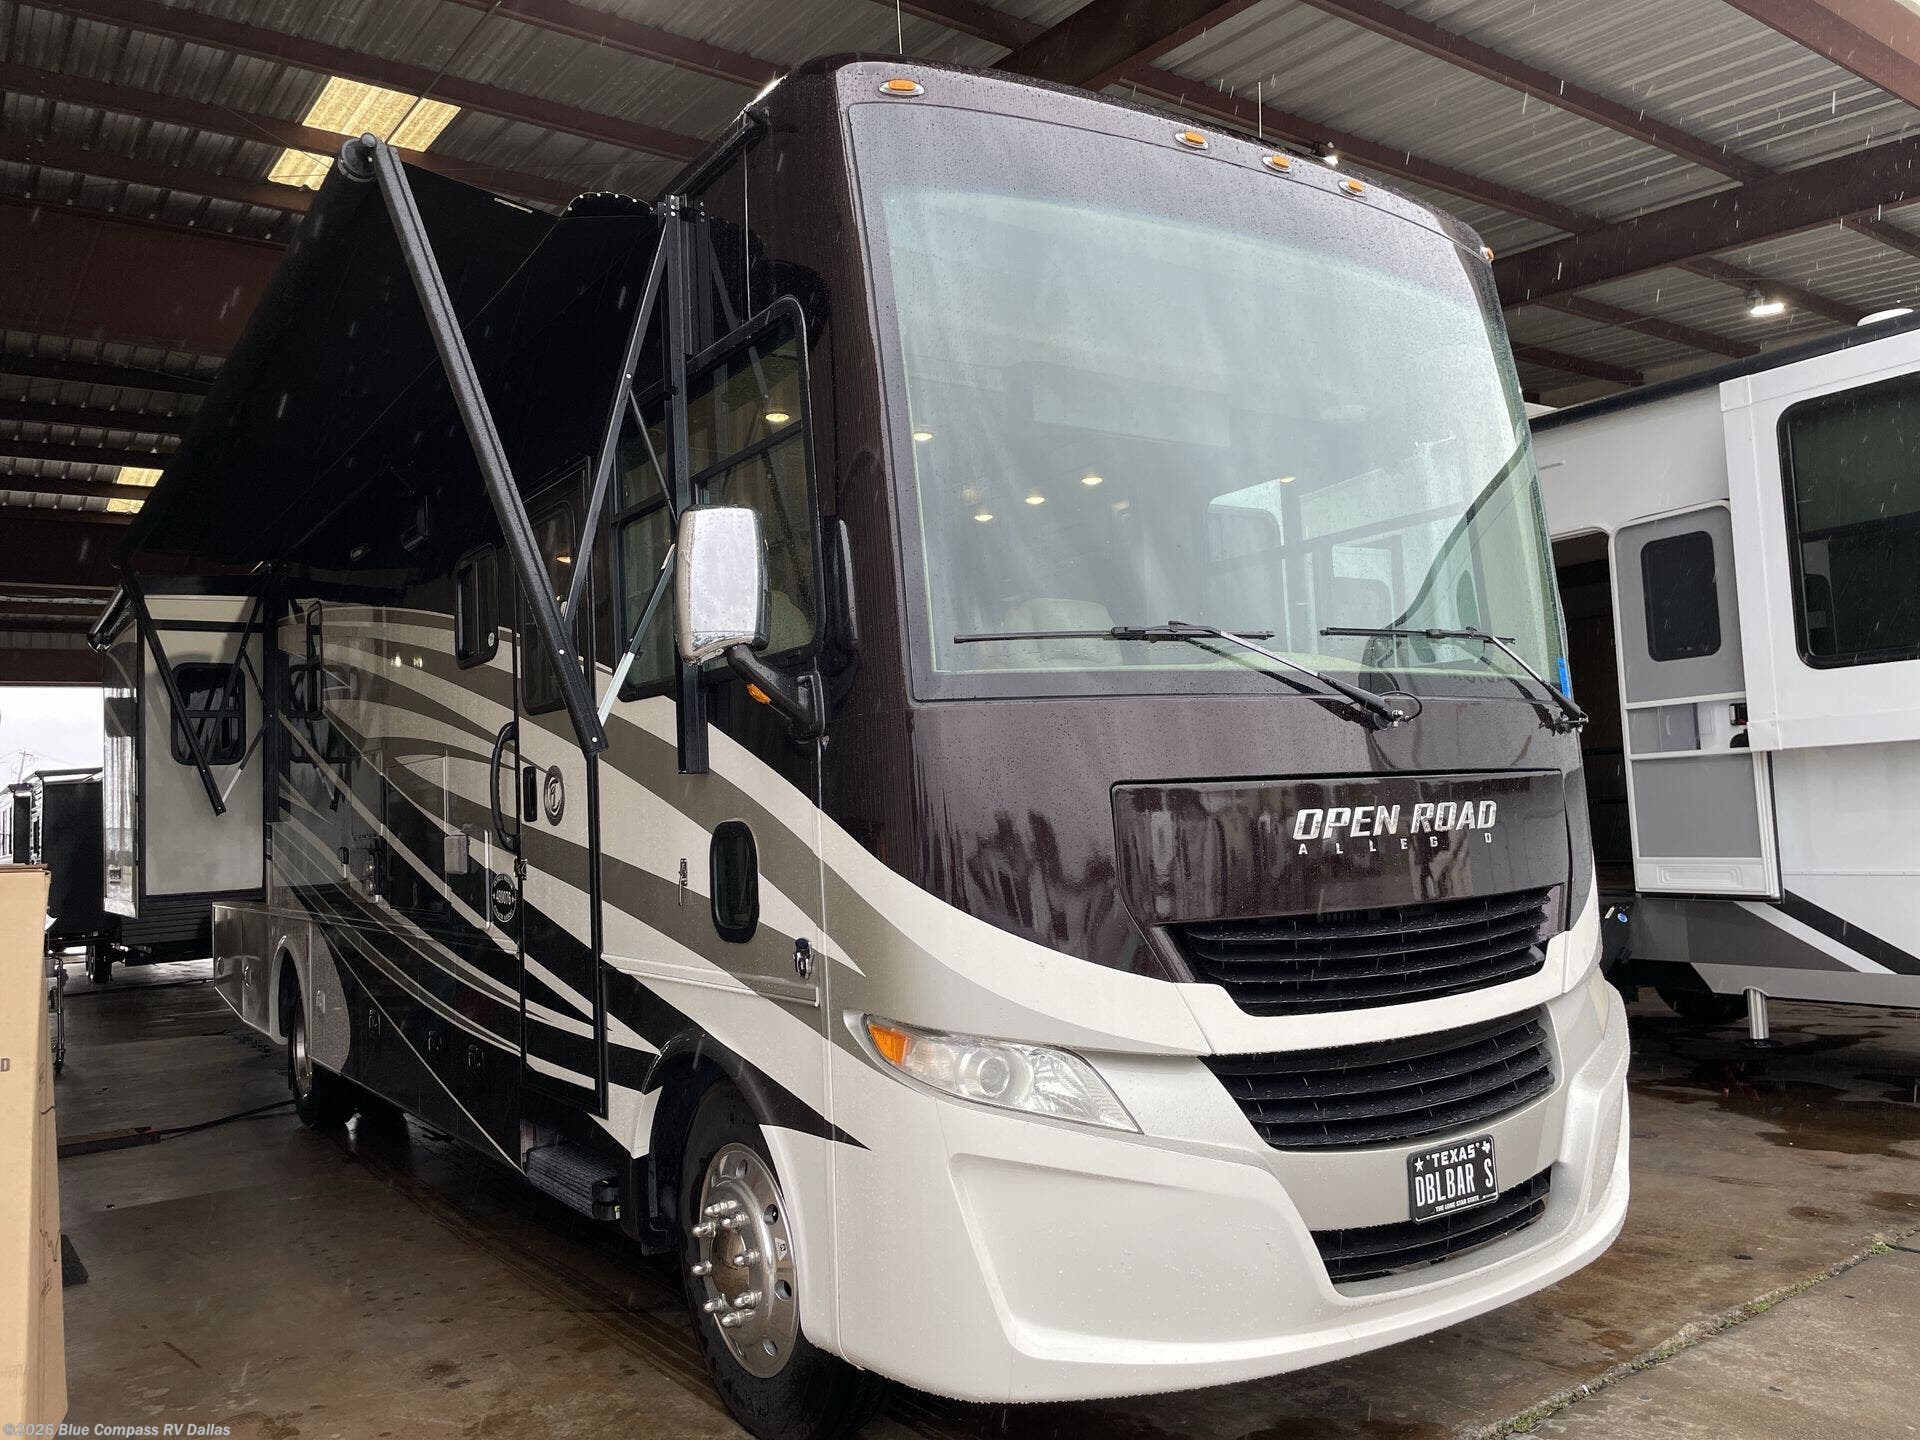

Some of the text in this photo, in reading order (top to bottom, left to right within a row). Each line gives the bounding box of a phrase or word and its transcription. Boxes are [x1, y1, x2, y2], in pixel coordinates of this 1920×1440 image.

[1292, 800, 1497, 840] OPEN ROAD
[1431, 1144, 1476, 1168] TEXAS
